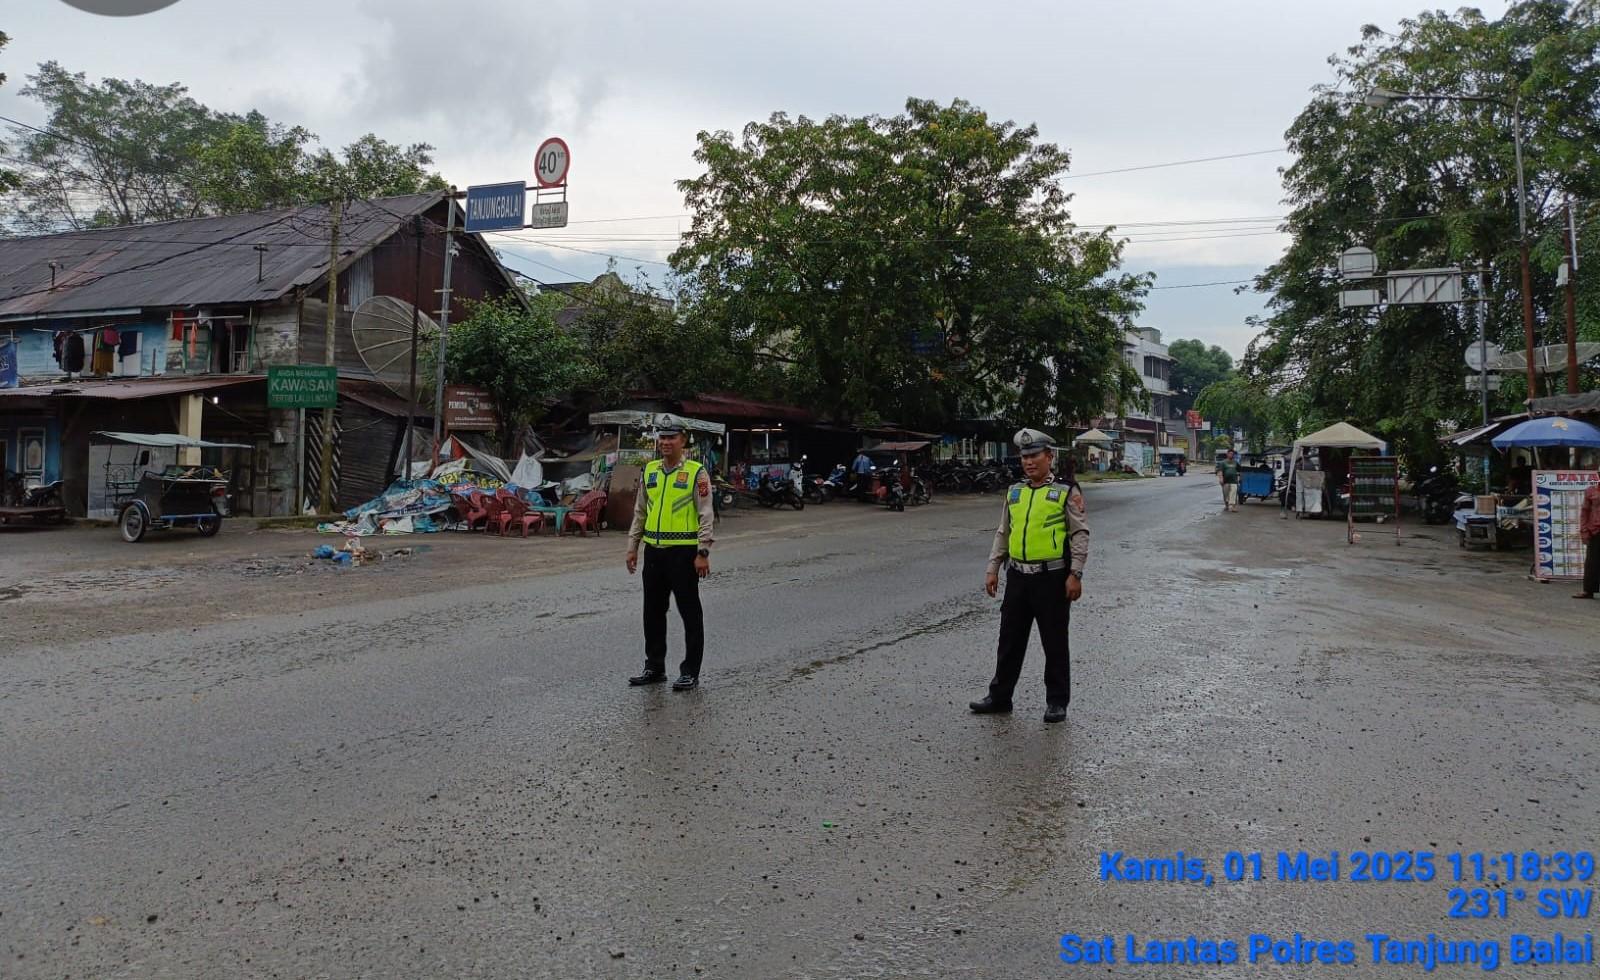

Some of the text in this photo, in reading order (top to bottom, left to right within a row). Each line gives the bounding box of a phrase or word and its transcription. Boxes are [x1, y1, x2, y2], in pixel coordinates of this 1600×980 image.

[539, 151, 557, 174] 40
[470, 194, 522, 221] TANJUNGBALAI
[271, 378, 334, 392] KAWASAN
[1557, 473, 1599, 481] DATA
